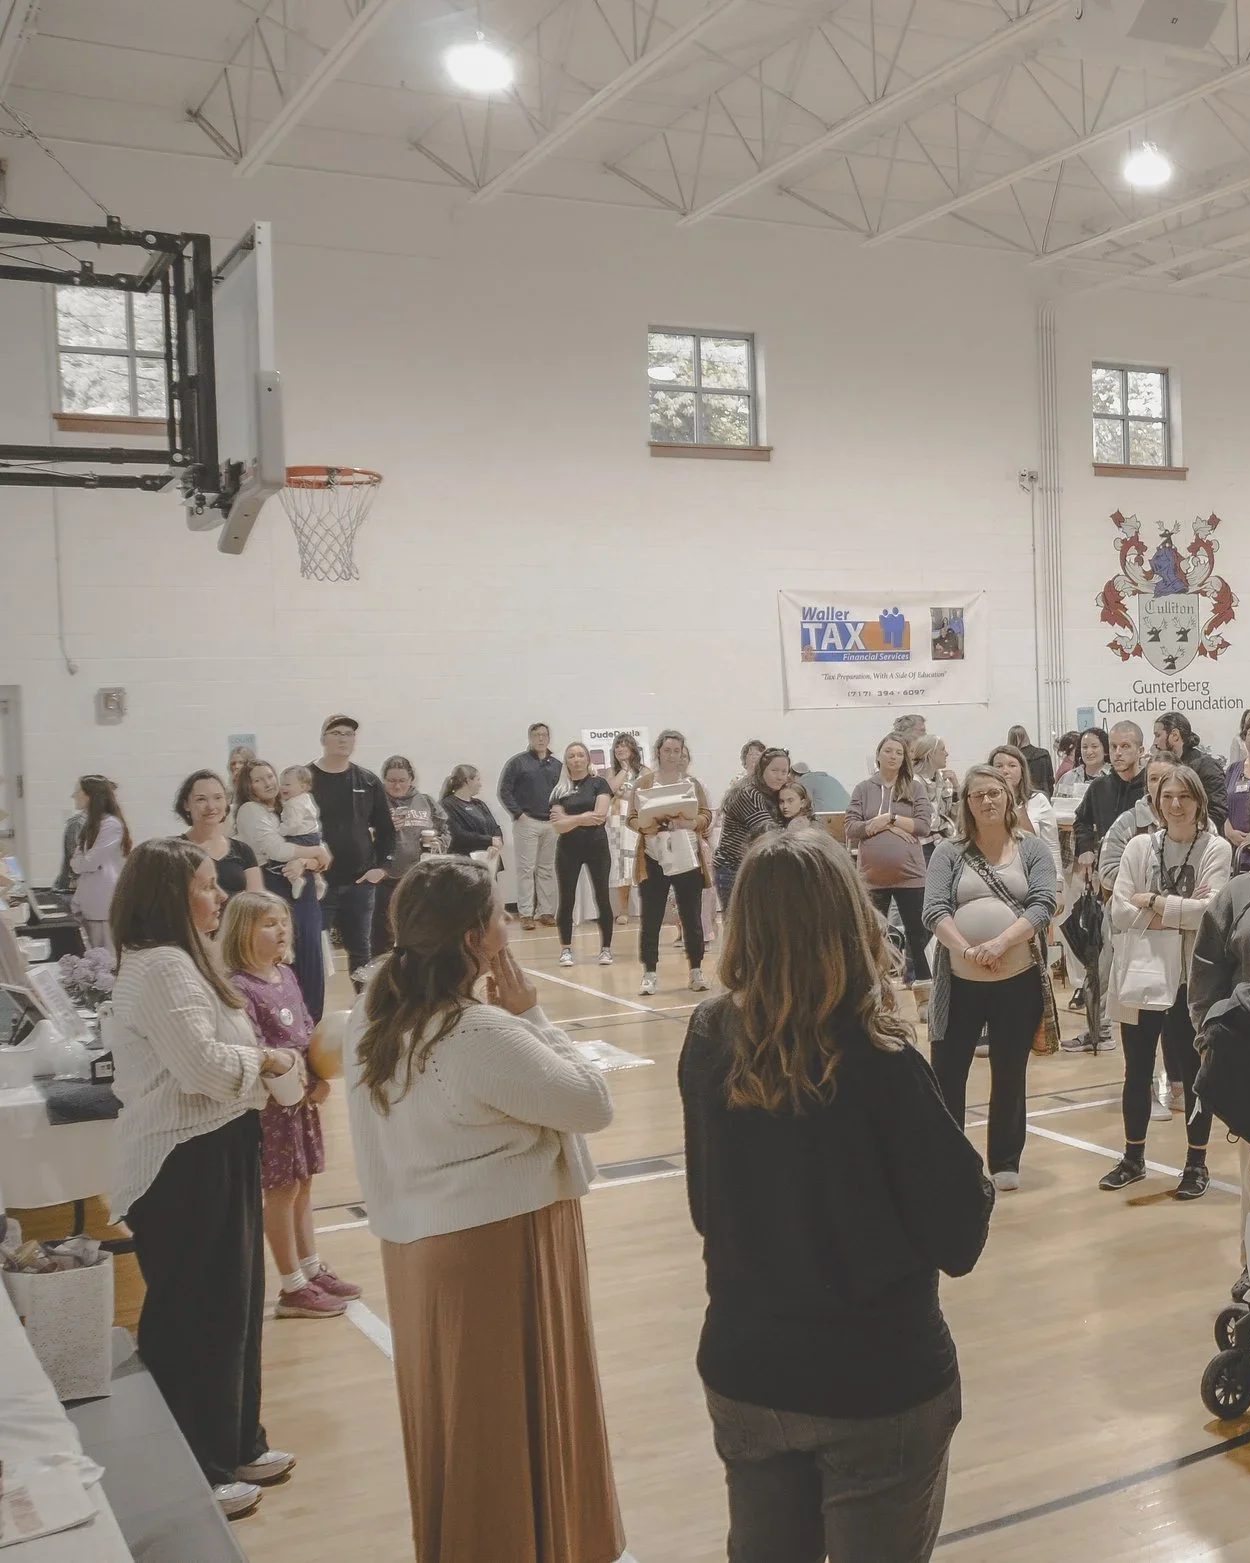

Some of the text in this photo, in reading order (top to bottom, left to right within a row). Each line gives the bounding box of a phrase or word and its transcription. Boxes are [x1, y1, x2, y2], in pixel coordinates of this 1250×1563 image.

[802, 606, 849, 620] Waller
[803, 623, 865, 650] TAX
[842, 653, 877, 661] Financial
[879, 653, 909, 661] Services
[837, 673, 872, 682] Preparation,
[908, 672, 916, 680] Of
[1132, 678, 1210, 695] Gunterberg
[1097, 696, 1244, 713] Charitable Foundation
